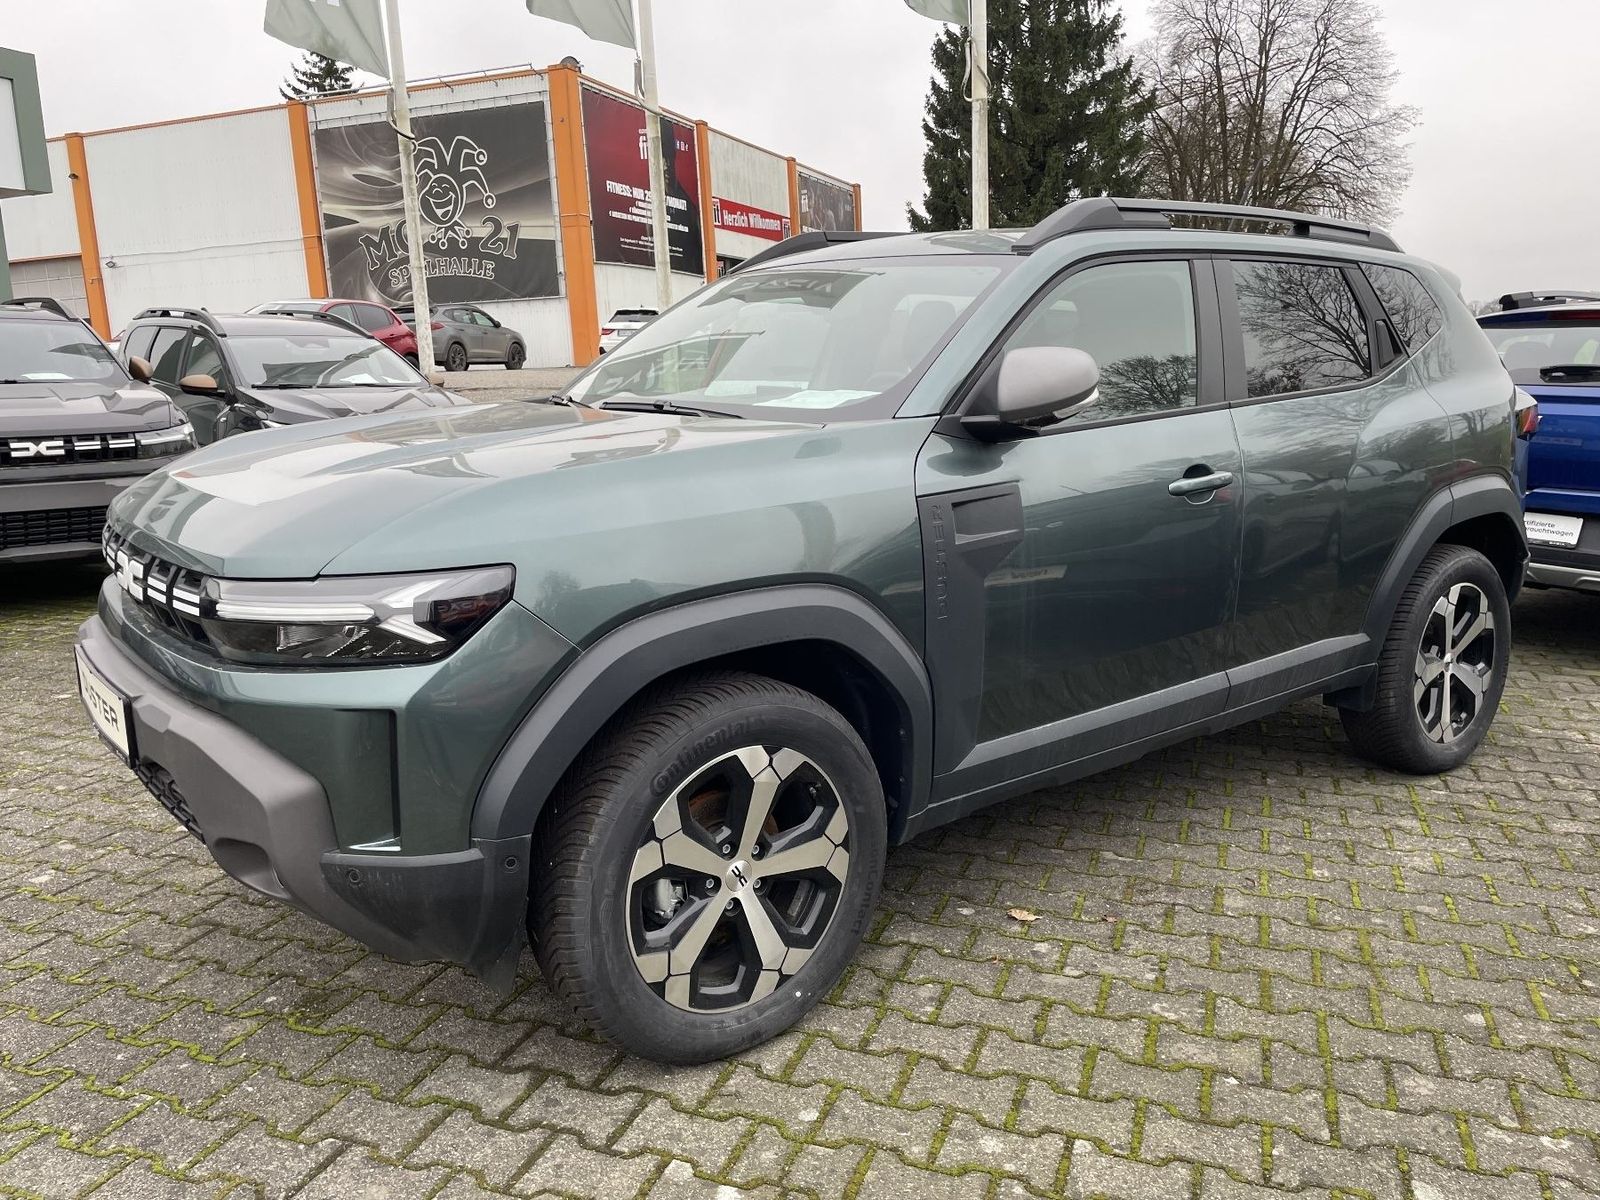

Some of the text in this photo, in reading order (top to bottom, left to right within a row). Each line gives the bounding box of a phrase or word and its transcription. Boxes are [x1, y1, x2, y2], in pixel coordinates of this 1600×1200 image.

[723, 209, 749, 228] Herzlich
[748, 212, 781, 231] Willkommen
[479, 215, 521, 260] 21
[388, 256, 496, 288] SPLHALLE
